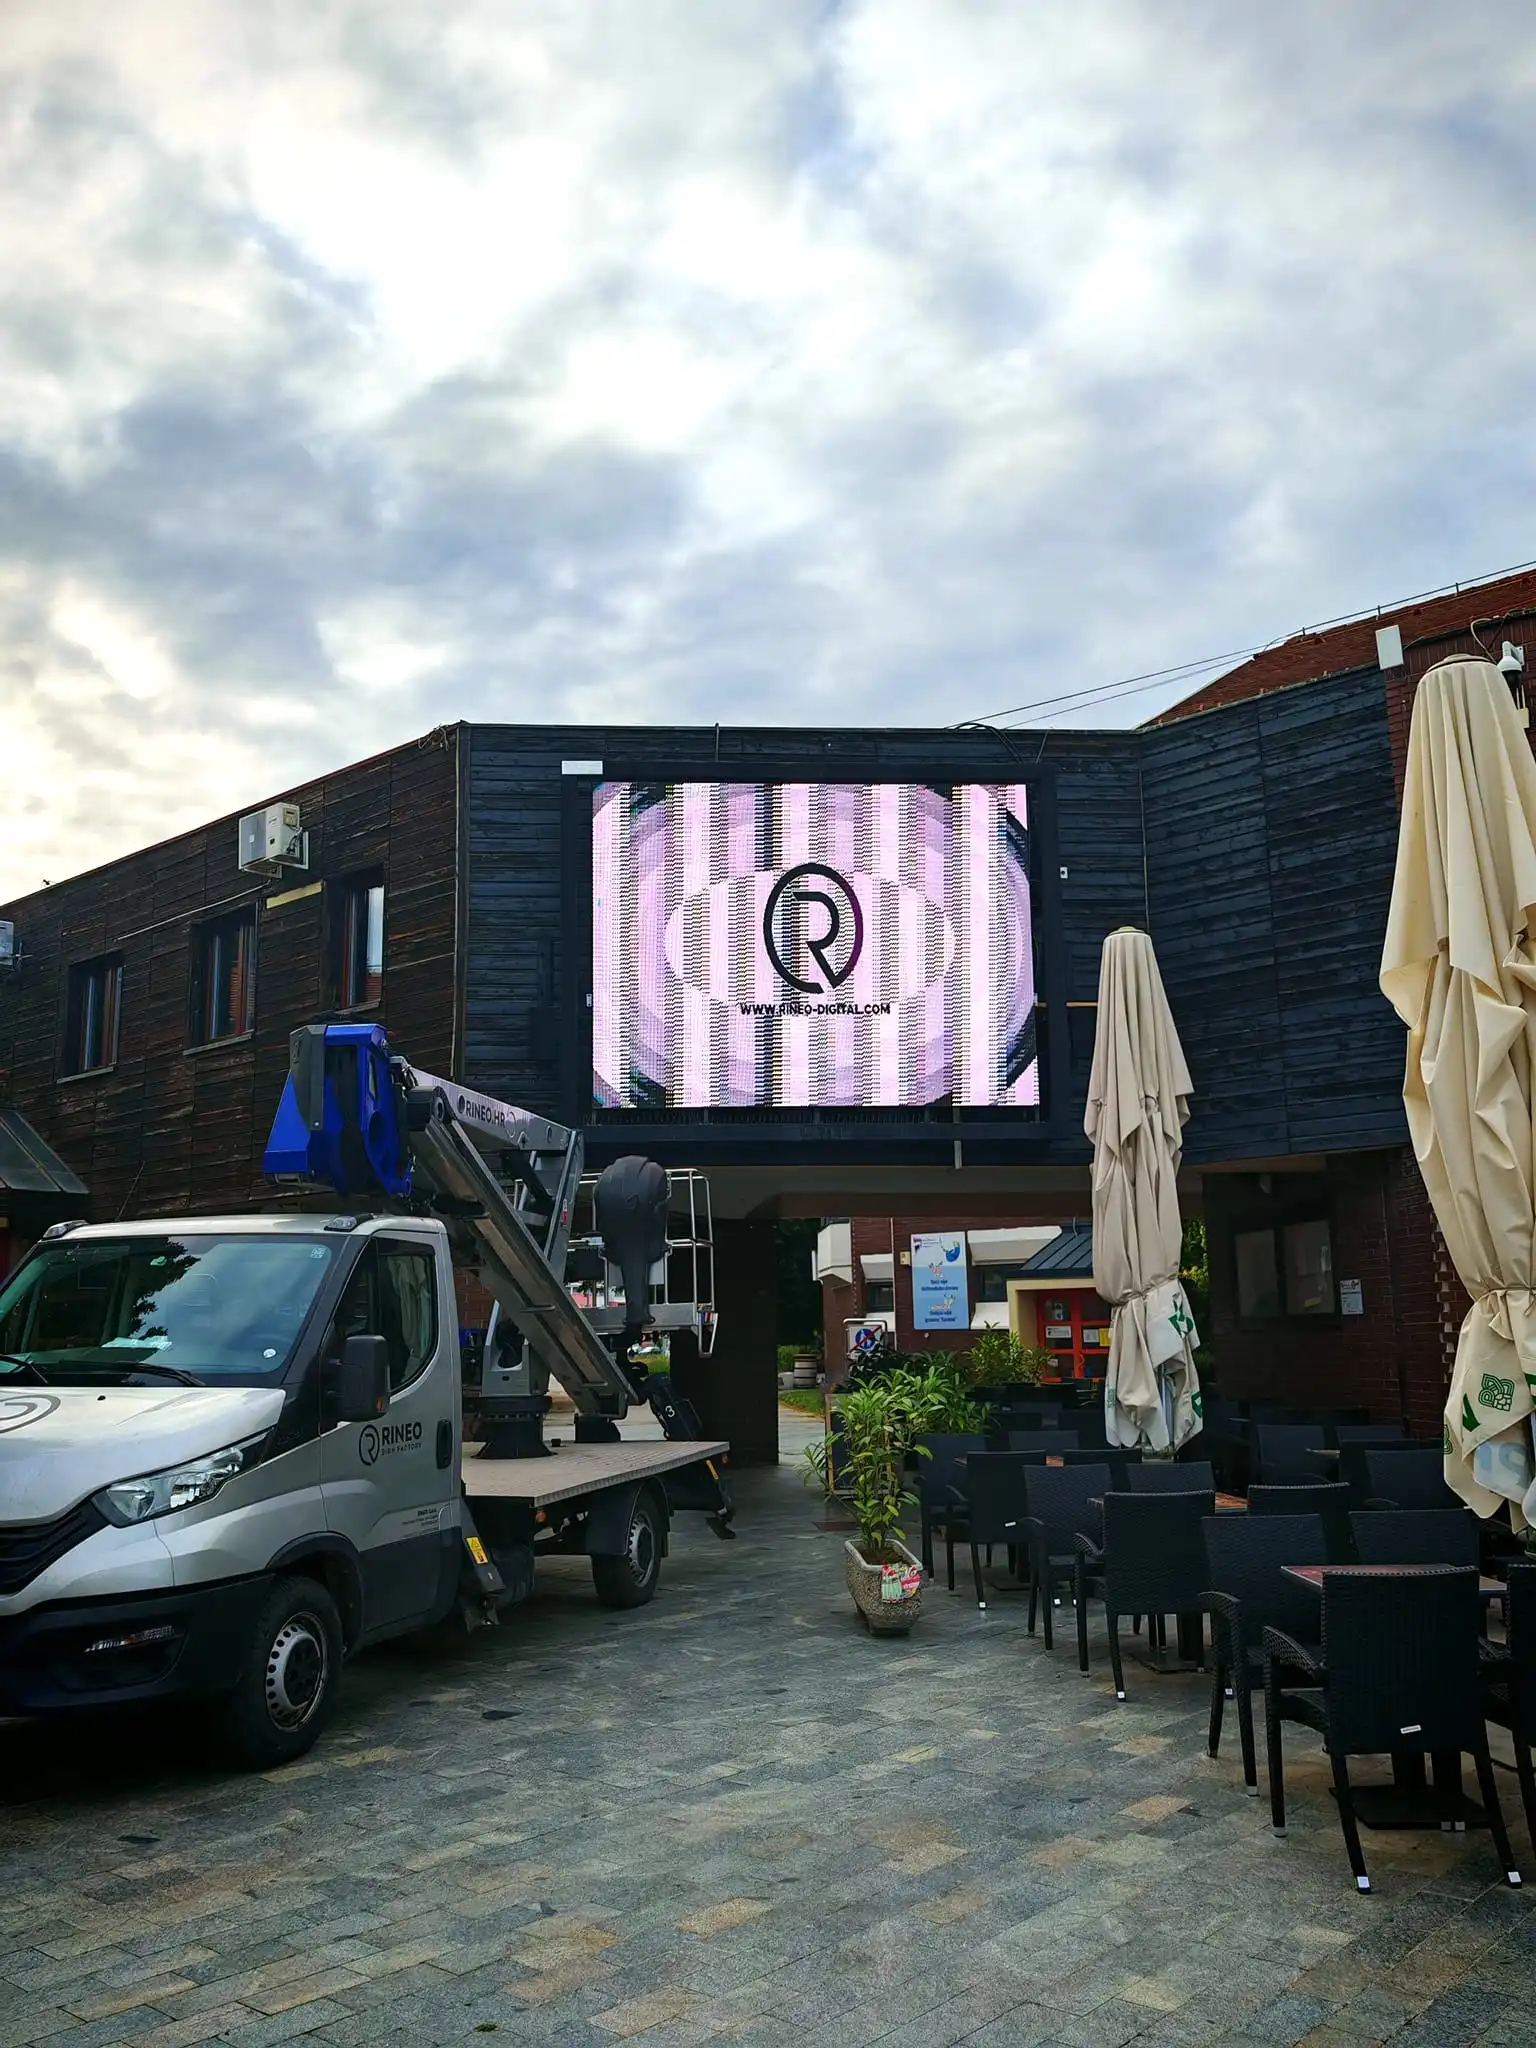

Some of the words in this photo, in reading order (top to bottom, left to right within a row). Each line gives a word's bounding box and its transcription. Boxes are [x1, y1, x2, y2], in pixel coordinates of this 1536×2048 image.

[740, 1002, 891, 1016] WWW.RINEO-DIGITAL.COM
[465, 1100, 506, 1128] RINEO.HR
[665, 1405, 676, 1418] 3
[382, 1421, 422, 1445] RINEO
